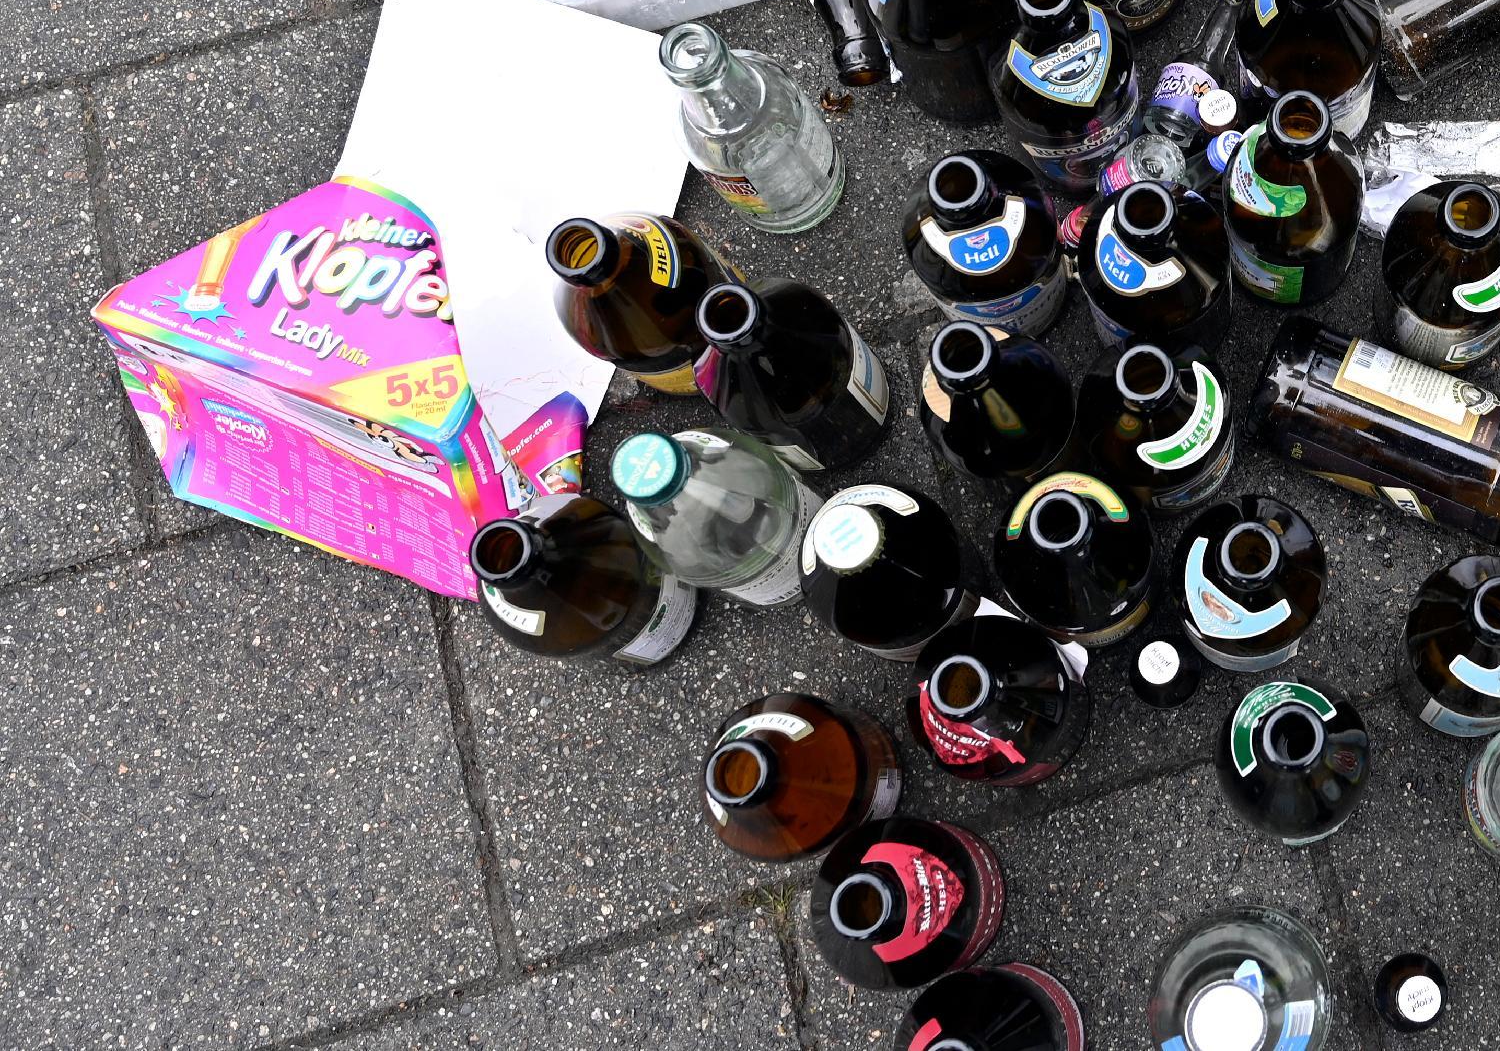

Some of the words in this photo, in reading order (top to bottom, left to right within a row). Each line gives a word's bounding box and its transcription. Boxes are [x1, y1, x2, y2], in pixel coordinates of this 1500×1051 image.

[1036, 36, 1097, 72] RECKENDORFER
[339, 212, 431, 248] kleiner
[653, 237, 668, 276] HELL
[964, 243, 1000, 265] Hell
[1103, 253, 1130, 285] Hell
[270, 306, 344, 359] Lady
[336, 341, 372, 367] Mix
[411, 399, 448, 410] Flaschen
[415, 408, 425, 417] je
[424, 407, 435, 416] 20
[436, 405, 447, 413] ml
[214, 414, 268, 441] Klopfer
[507, 417, 553, 457] lopfer.com
[1180, 404, 1213, 451] HELLES
[934, 734, 969, 757] HELL
[935, 870, 948, 912] HELL
